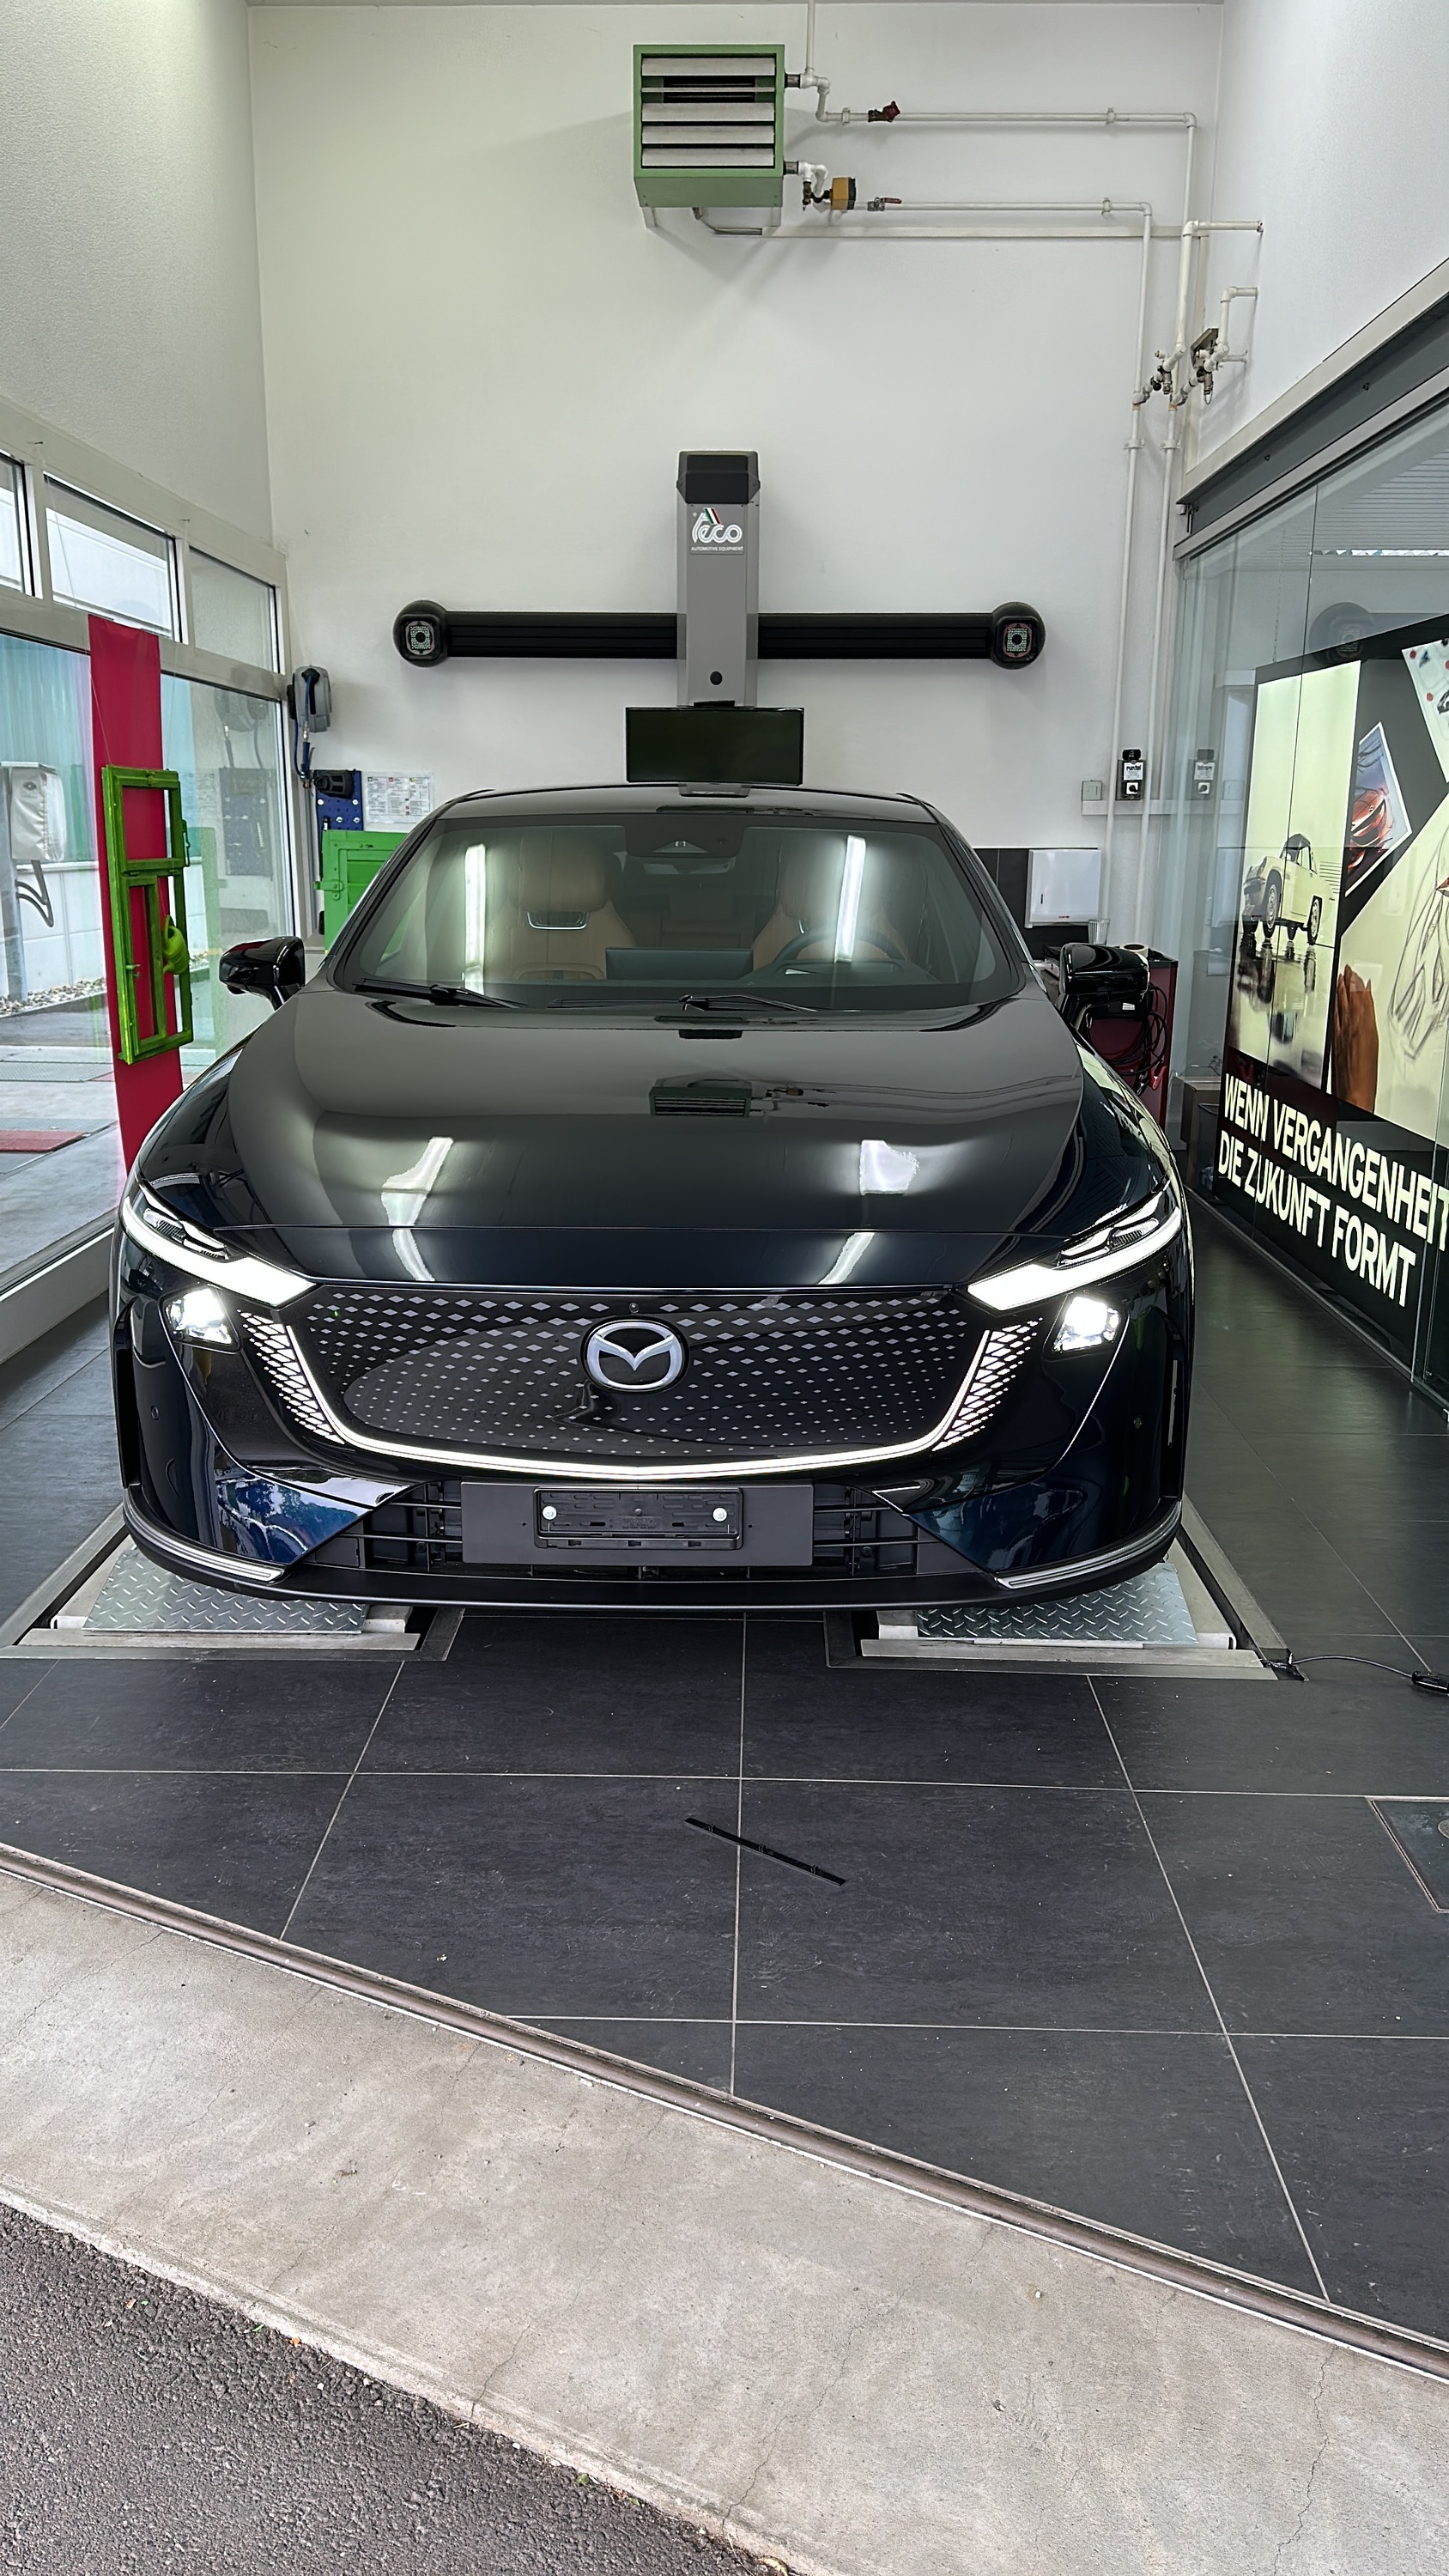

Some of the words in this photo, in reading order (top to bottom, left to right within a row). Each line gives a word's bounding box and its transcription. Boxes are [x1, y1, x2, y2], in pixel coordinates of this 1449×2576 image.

[1218, 1130, 1244, 1188] DIE
[1245, 1151, 1331, 1248] ZUKUNFT
[1331, 1205, 1416, 1307] FORMT
[1224, 1073, 1270, 1141] WENN
[1274, 1099, 1449, 1252] VERGANGENHEIT
